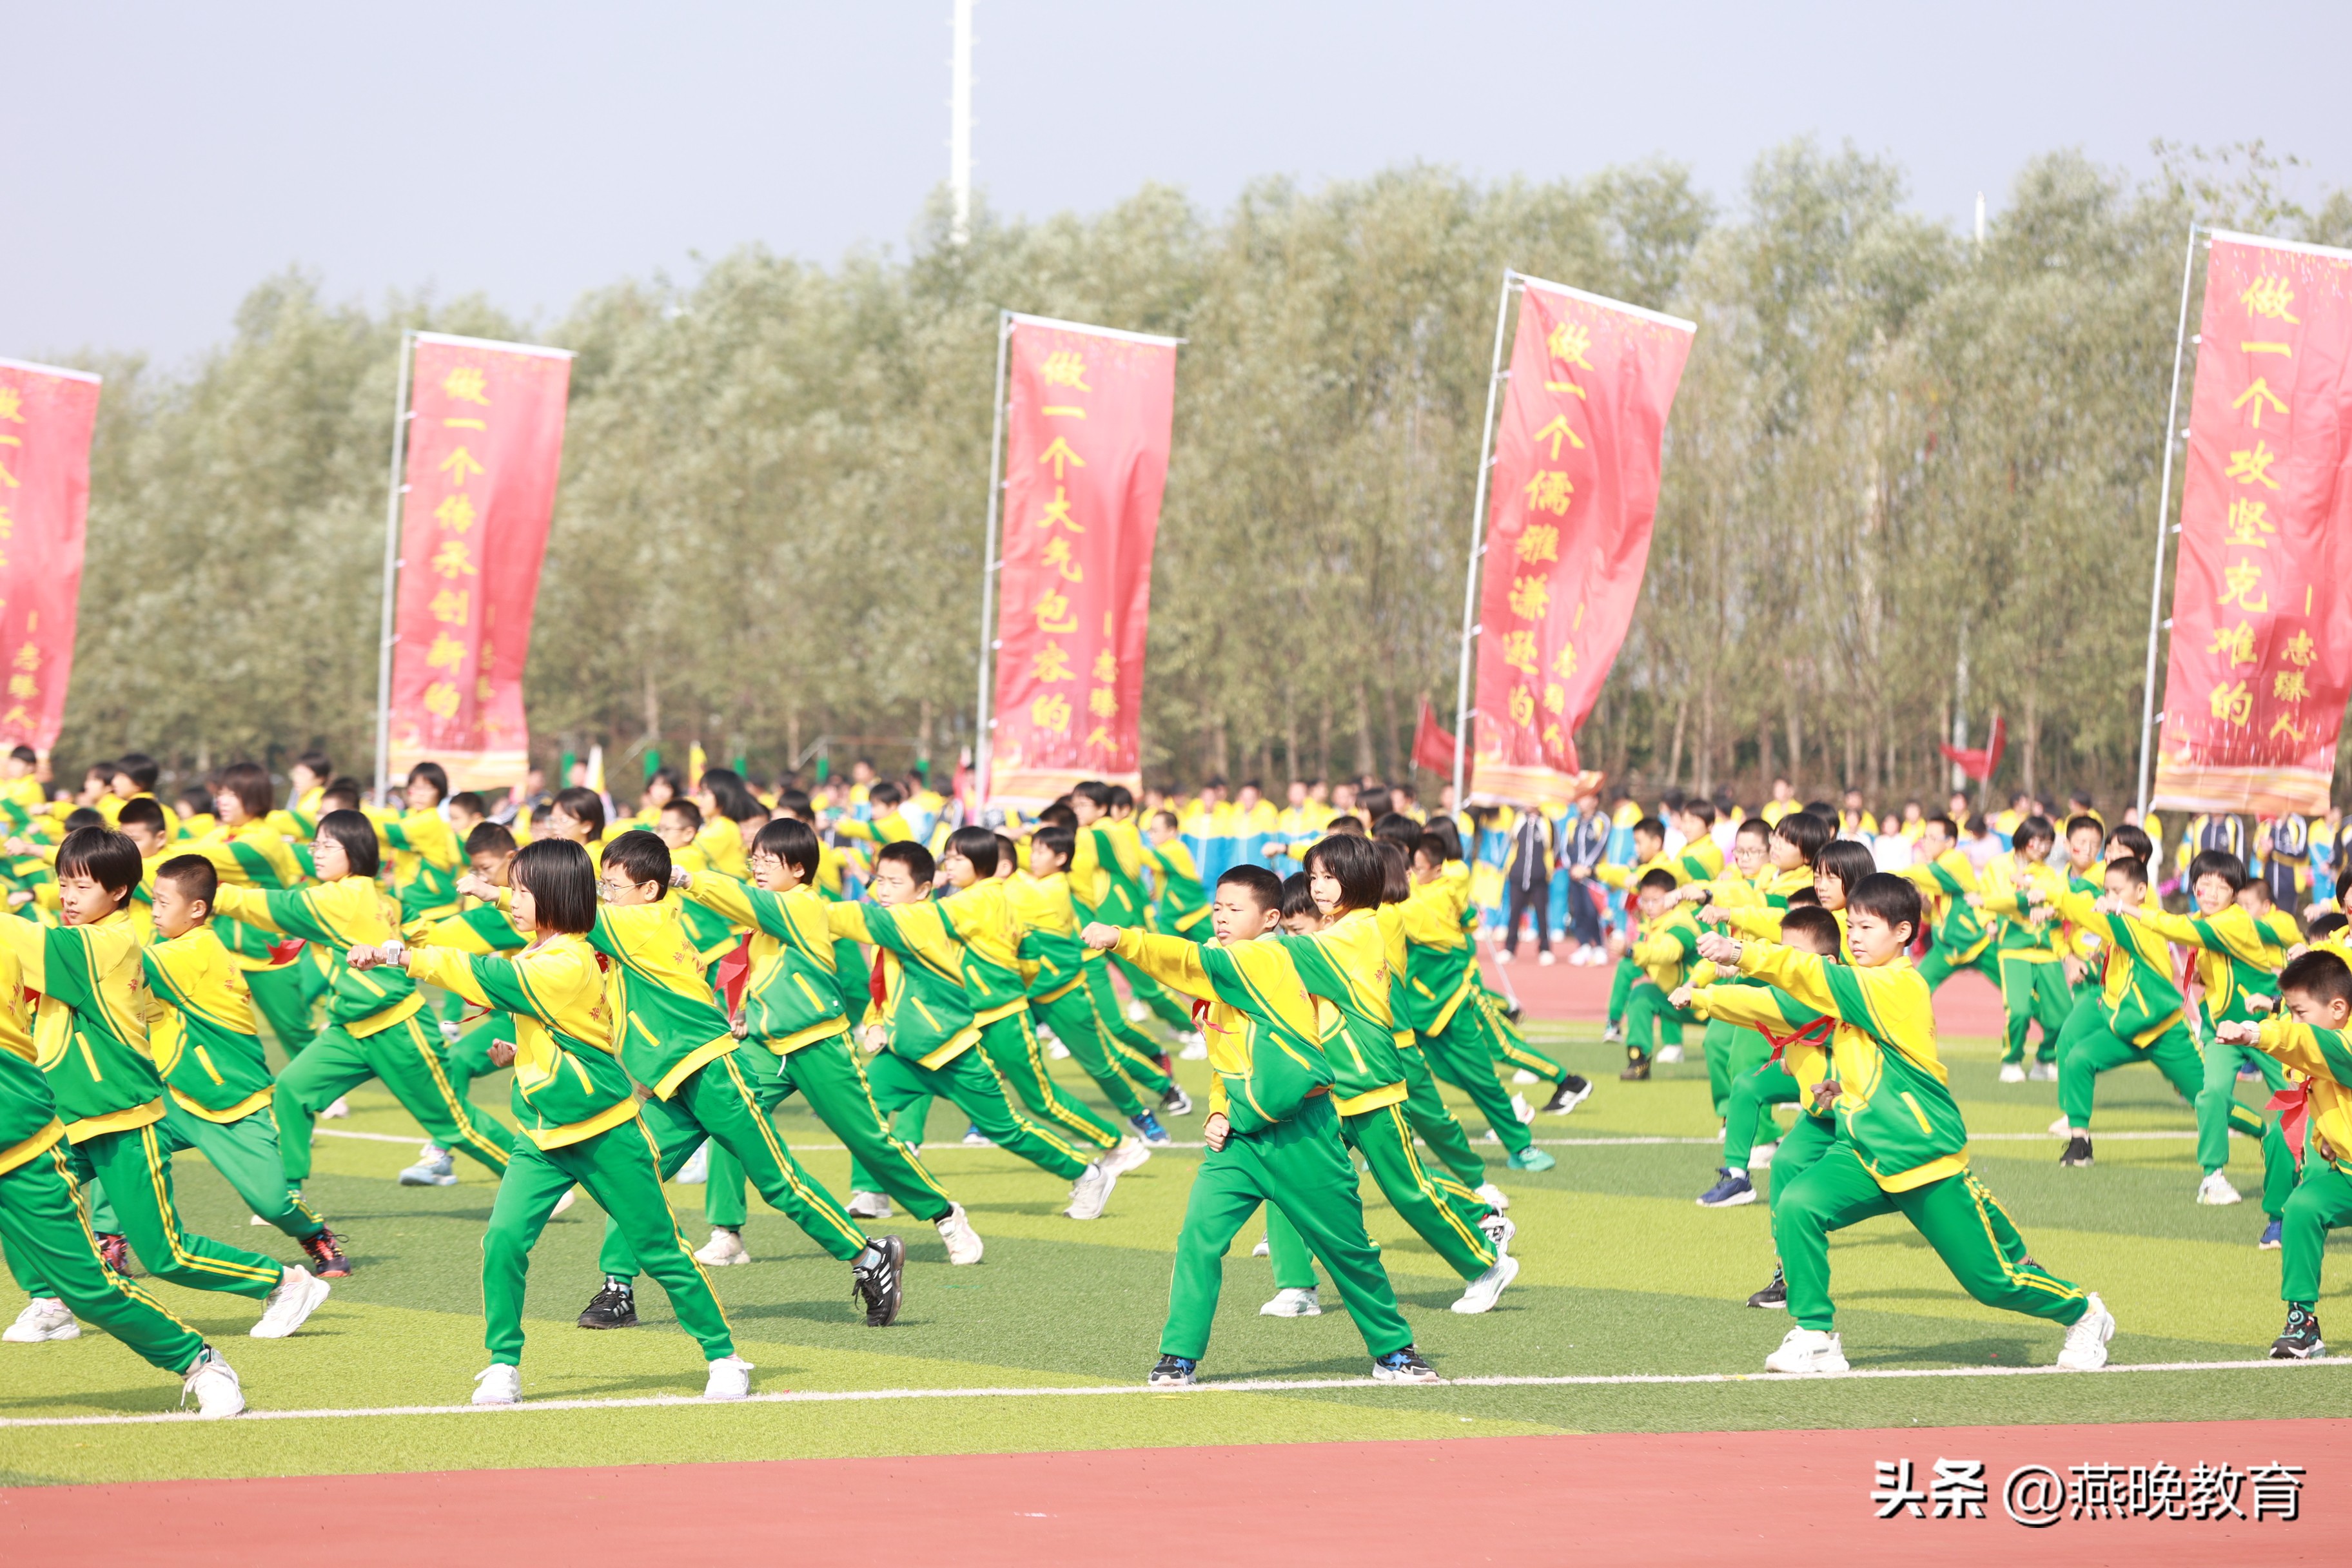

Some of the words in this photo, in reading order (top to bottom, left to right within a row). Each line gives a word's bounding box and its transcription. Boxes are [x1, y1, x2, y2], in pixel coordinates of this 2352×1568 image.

[1030, 350, 1092, 734] 做一个大气包容的
[2206, 276, 2301, 729] 做一个攻坚克难的
